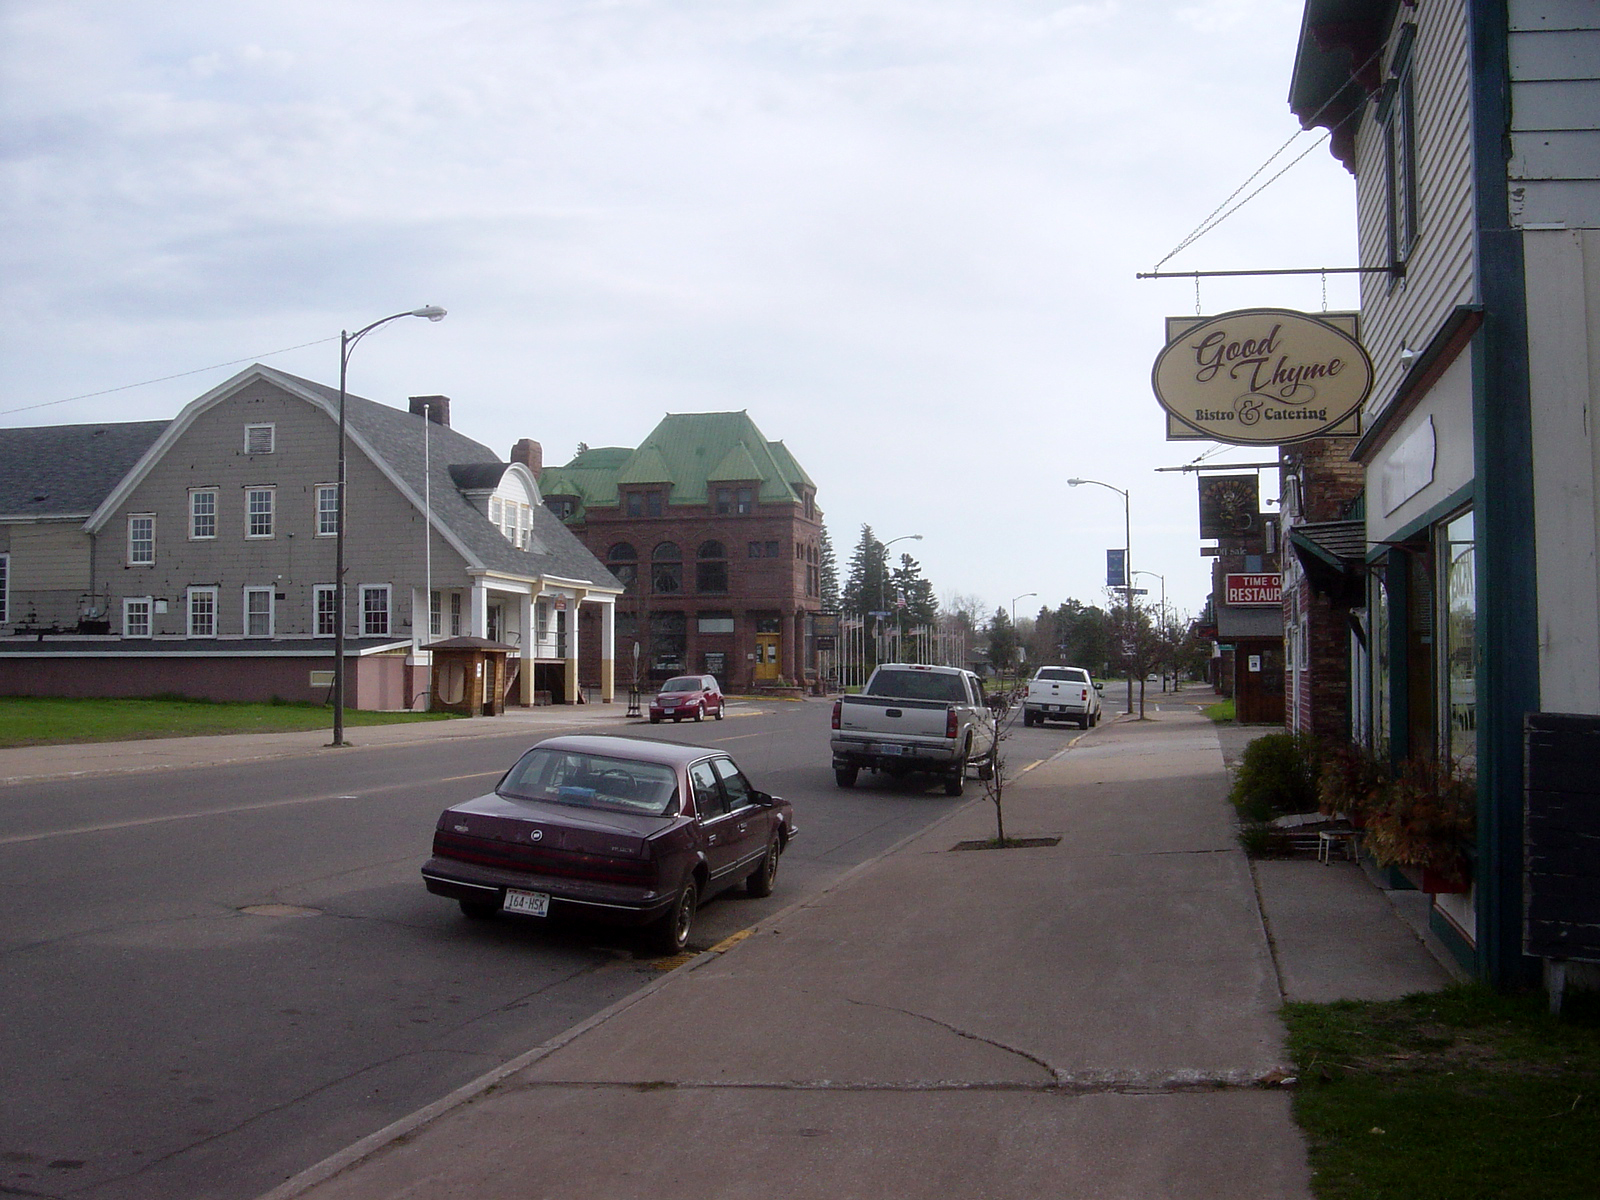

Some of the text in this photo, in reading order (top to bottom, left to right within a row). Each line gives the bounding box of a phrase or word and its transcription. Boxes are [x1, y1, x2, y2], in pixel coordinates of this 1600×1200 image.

[1191, 324, 1281, 382] Good
[1229, 355, 1345, 400] Thyme
[1195, 400, 1328, 426] Bistro & Catering
[1242, 576, 1268, 586] TIME
